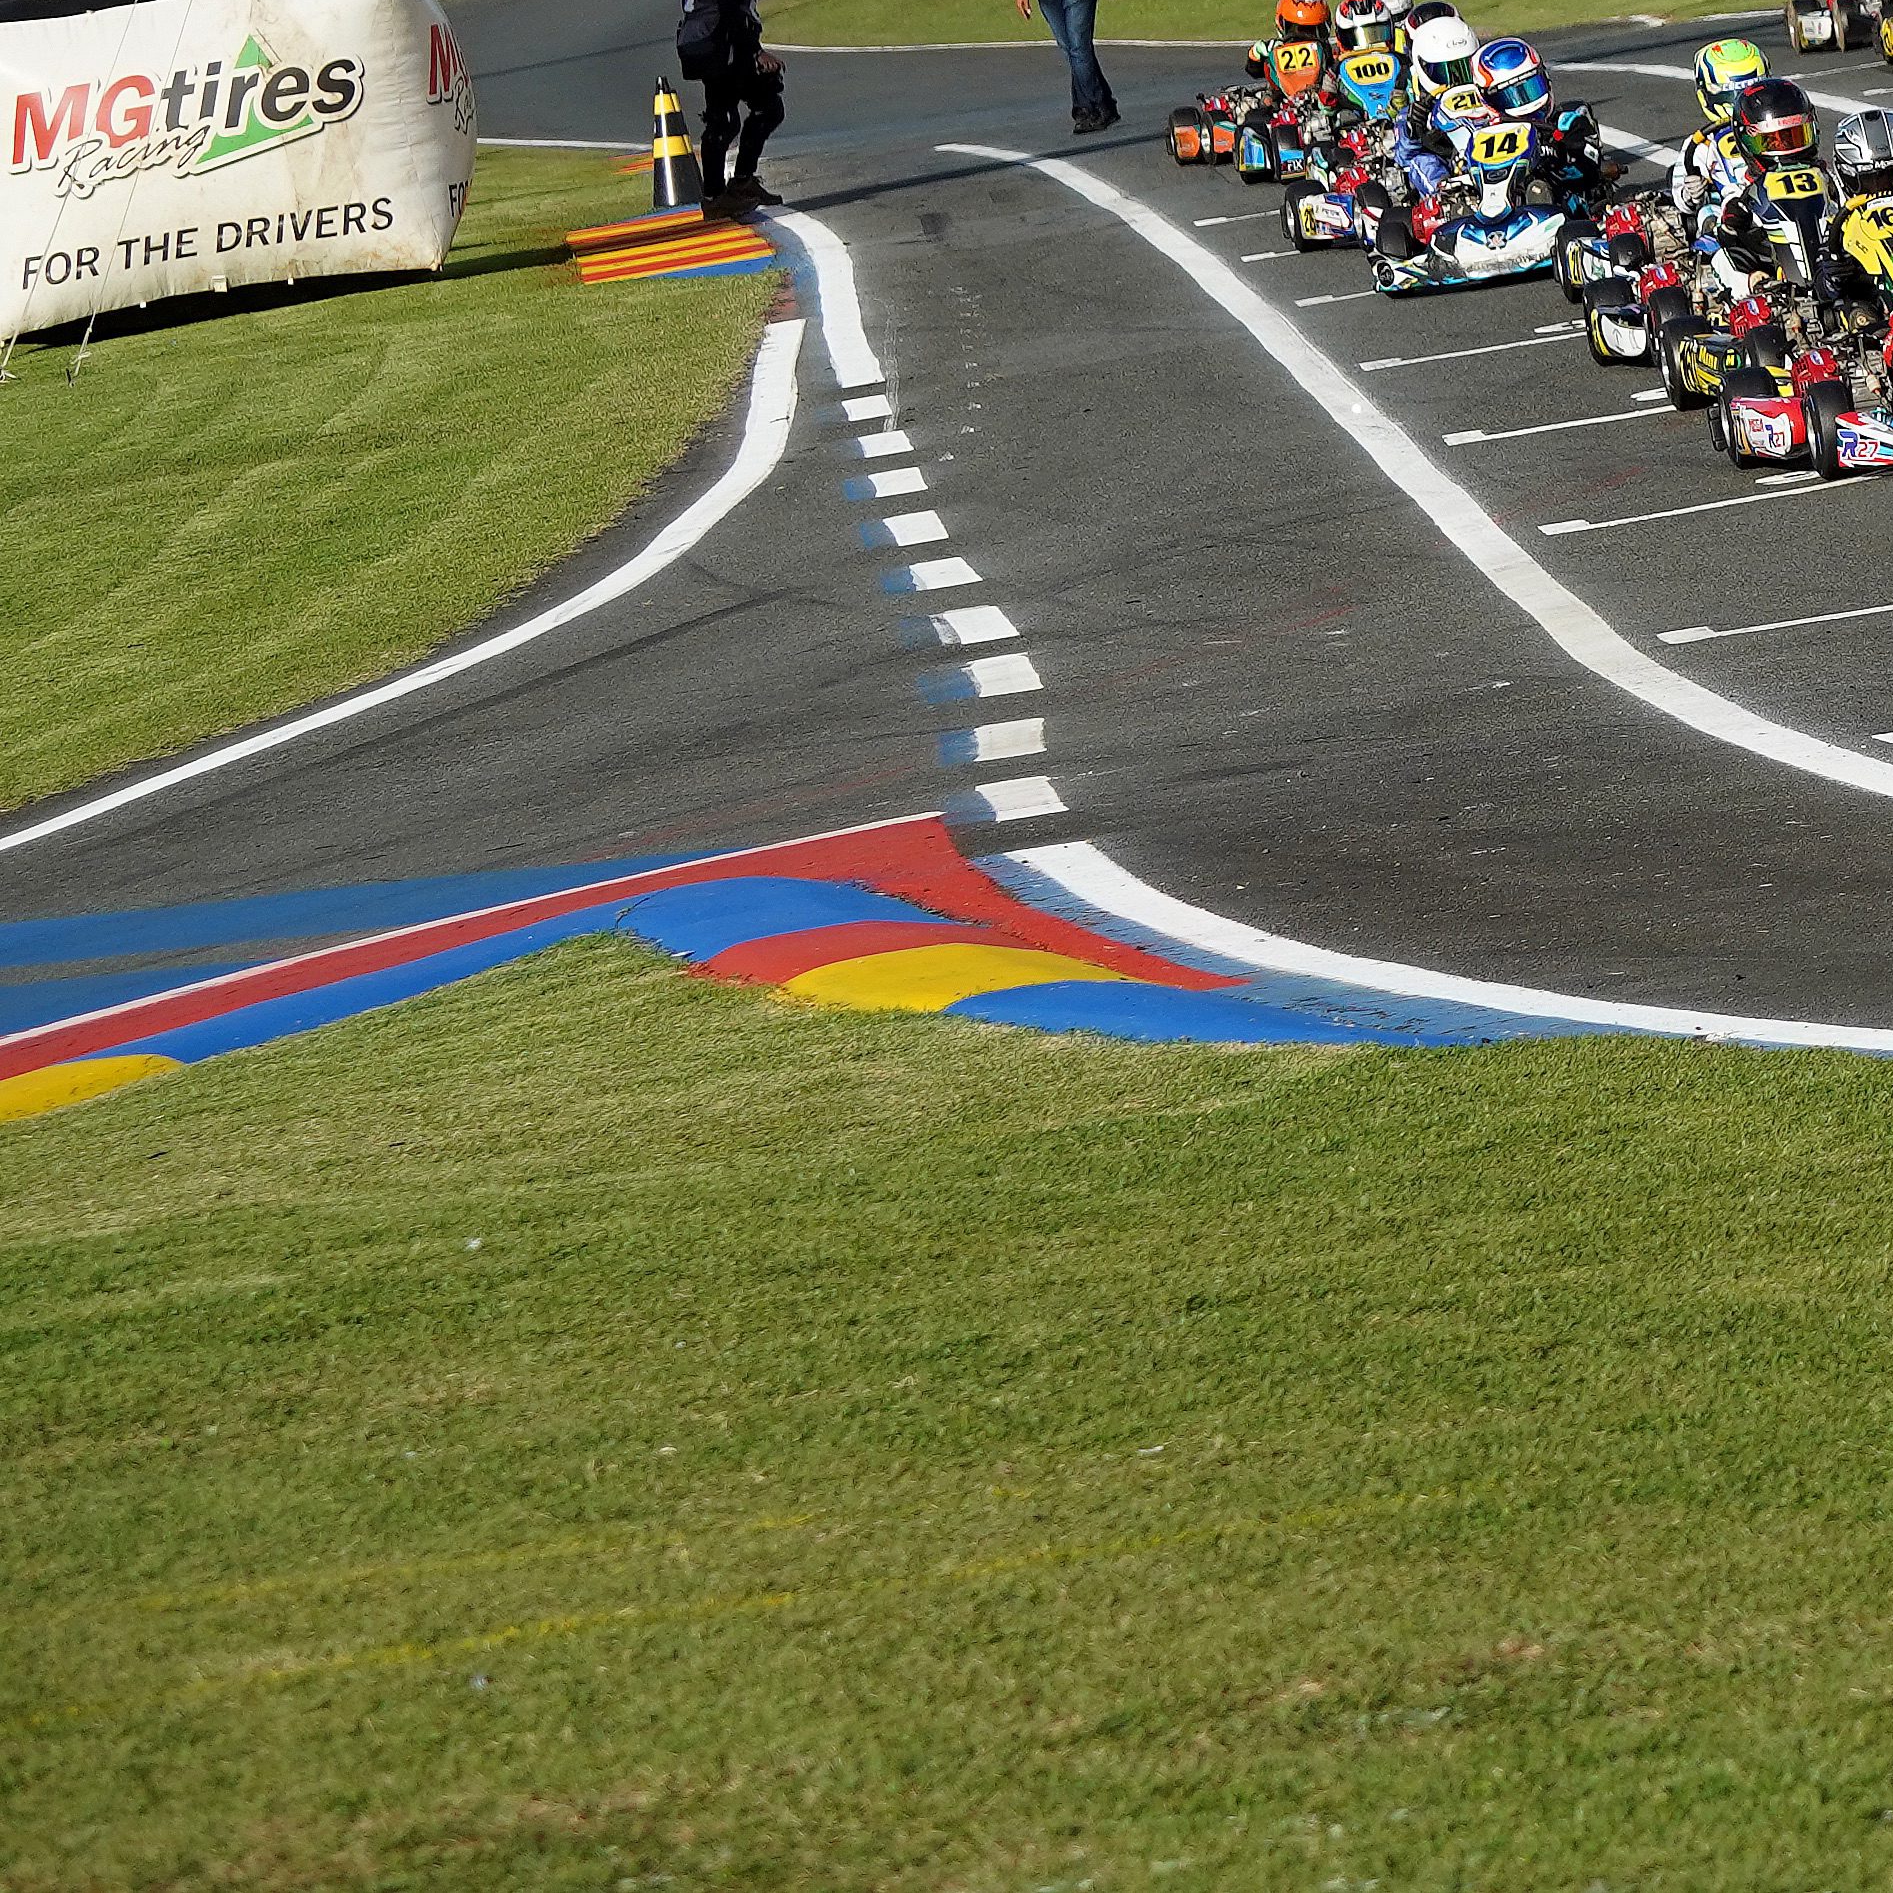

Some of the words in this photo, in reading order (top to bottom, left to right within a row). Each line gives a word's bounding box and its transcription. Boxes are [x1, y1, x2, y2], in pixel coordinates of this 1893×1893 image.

[1280, 47, 1314, 71] 22
[1351, 61, 1390, 80] 100
[12, 58, 358, 165] MGtires
[58, 124, 209, 188] Racing
[1480, 132, 1520, 159] 14
[448, 179, 473, 218] FO
[1776, 172, 1818, 196] 13
[22, 246, 101, 290] FOR
[118, 227, 199, 270] THE
[216, 197, 394, 254] DRIVERS
